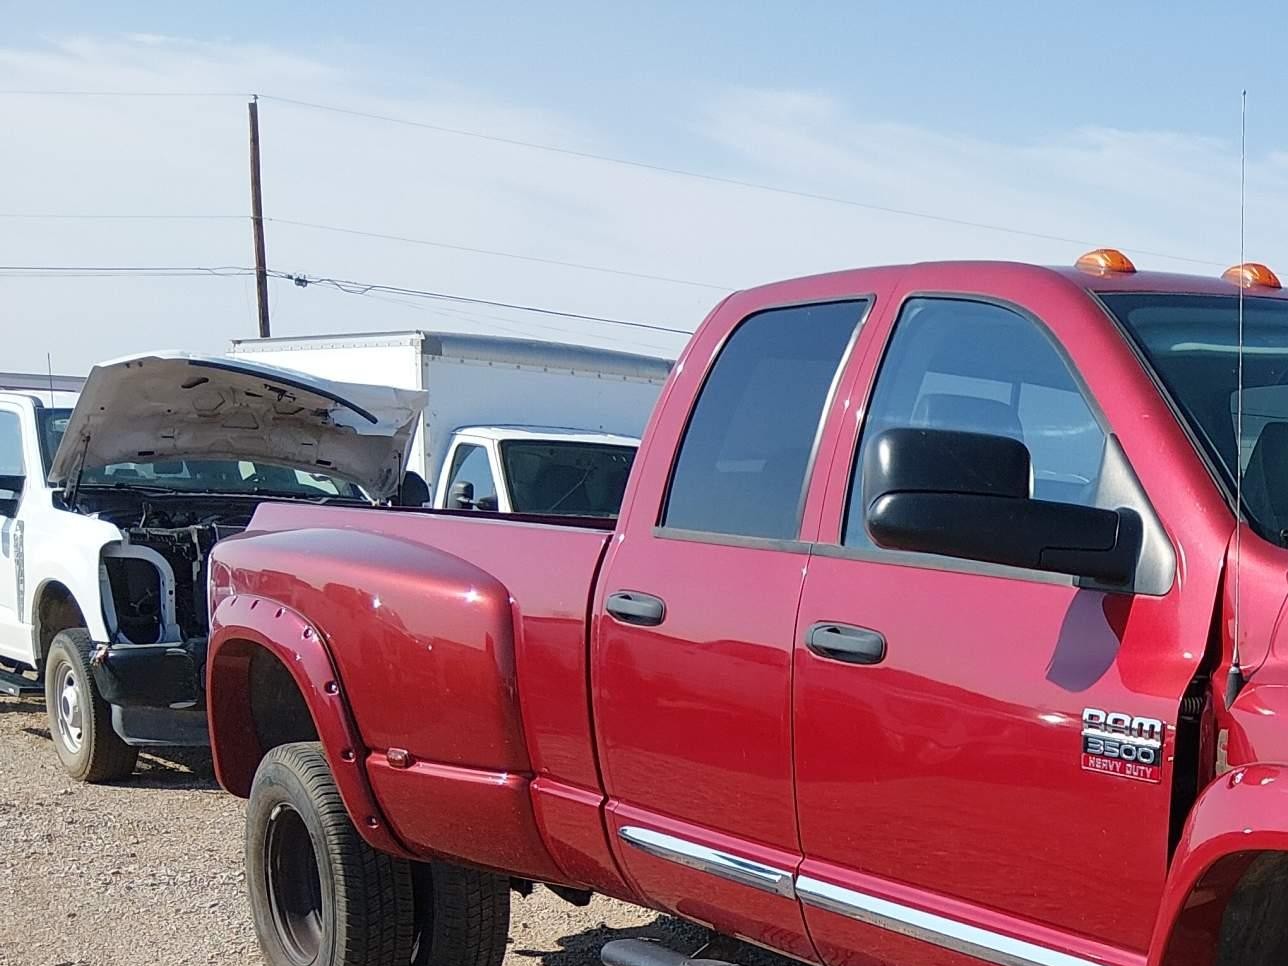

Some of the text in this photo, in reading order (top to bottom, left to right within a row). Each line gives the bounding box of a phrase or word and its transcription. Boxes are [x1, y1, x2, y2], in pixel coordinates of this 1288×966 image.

[1086, 737, 1155, 764] 3500
[1088, 755, 1153, 779] HEAVY DUTY
